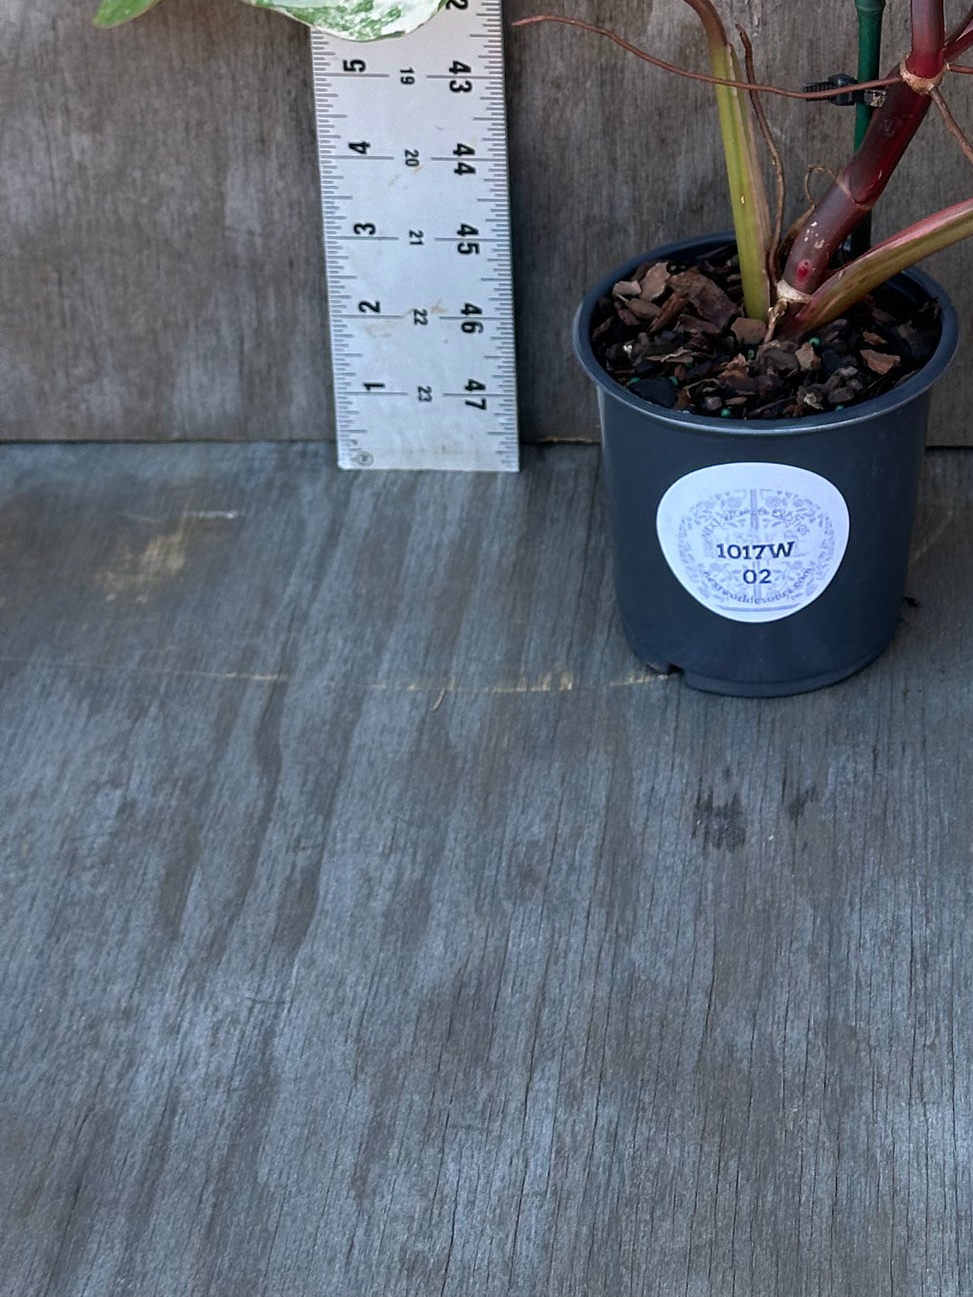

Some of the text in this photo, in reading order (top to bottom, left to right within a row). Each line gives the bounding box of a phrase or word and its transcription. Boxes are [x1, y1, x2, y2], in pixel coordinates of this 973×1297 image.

[343, 59, 366, 73] 5
[399, 66, 415, 85] 19
[449, 60, 472, 93] 43
[348, 141, 371, 154] 4
[404, 149, 420, 167] 20
[452, 143, 476, 176] 44
[353, 222, 376, 235] 3
[408, 230, 424, 246] 21
[456, 223, 480, 255] 45
[358, 300, 381, 313] 2
[413, 308, 429, 326] 22
[460, 303, 484, 334] 46
[363, 382, 385, 391] 1
[417, 385, 433, 402] 23
[464, 379, 487, 411] 47
[716, 541, 795, 560] 1017W
[743, 569, 772, 584] 02
